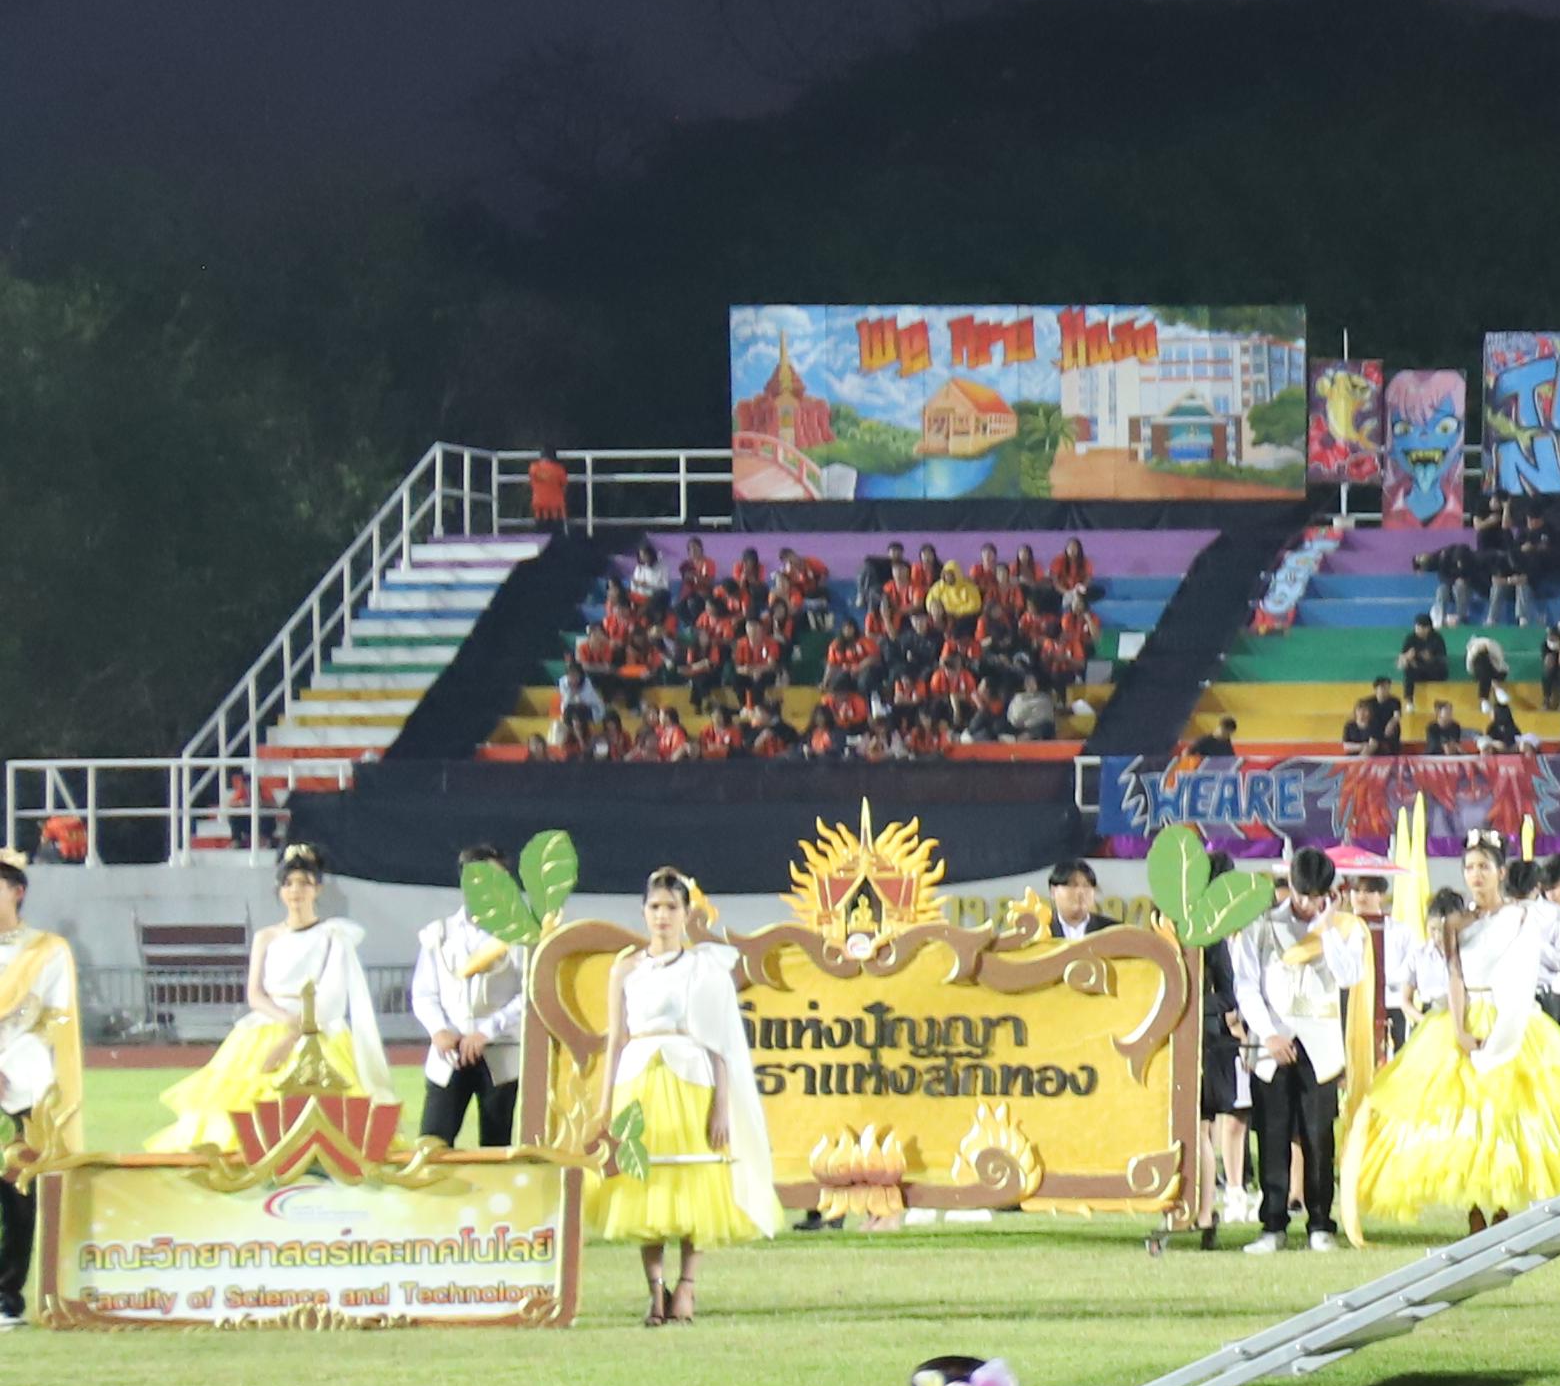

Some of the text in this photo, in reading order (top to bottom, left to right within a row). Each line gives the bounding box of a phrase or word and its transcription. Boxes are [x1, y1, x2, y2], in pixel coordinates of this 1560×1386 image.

[80, 1226, 555, 1270] คณะวิทยาศาสตร์และเทคโนโลยี
[80, 1281, 555, 1313] Faculty of Science and Technology
